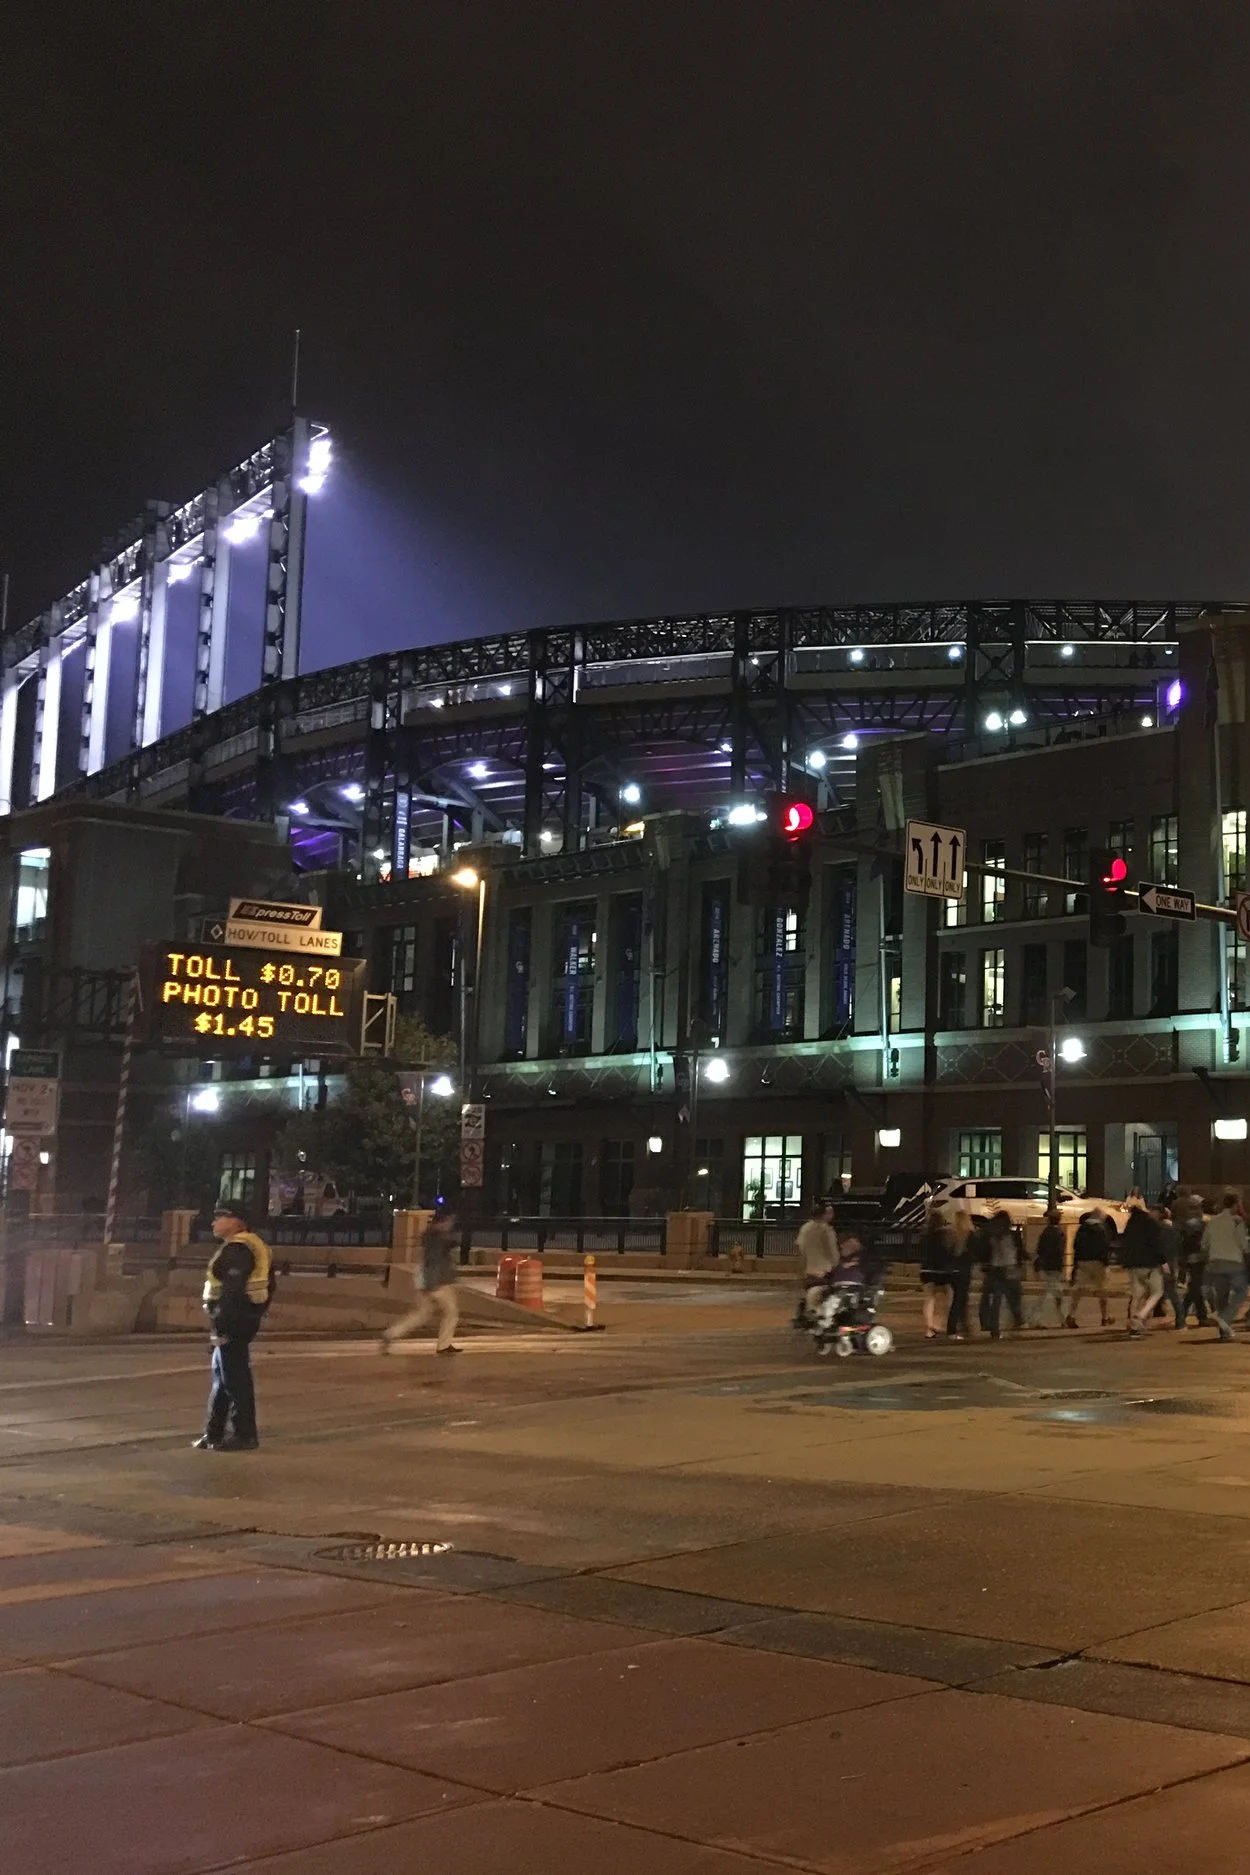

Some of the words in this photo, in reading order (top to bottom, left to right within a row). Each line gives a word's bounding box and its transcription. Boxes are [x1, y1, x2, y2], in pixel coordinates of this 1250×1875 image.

[907, 874, 925, 887] ONLY
[926, 877, 943, 890] ONLY
[944, 881, 961, 893] ONLY
[1156, 894, 1172, 909] ONE
[1173, 897, 1190, 911] WAY
[228, 928, 291, 945] HOV/TOLL
[300, 935, 339, 950] LANES
[775, 917, 784, 958] GONZALEZ
[167, 953, 241, 982] TOLL
[260, 962, 341, 990] $0.70
[569, 946, 578, 976] WALKER
[163, 981, 259, 1010] PHOTO
[277, 990, 345, 1018] TOLL
[194, 1011, 275, 1039] $1.45
